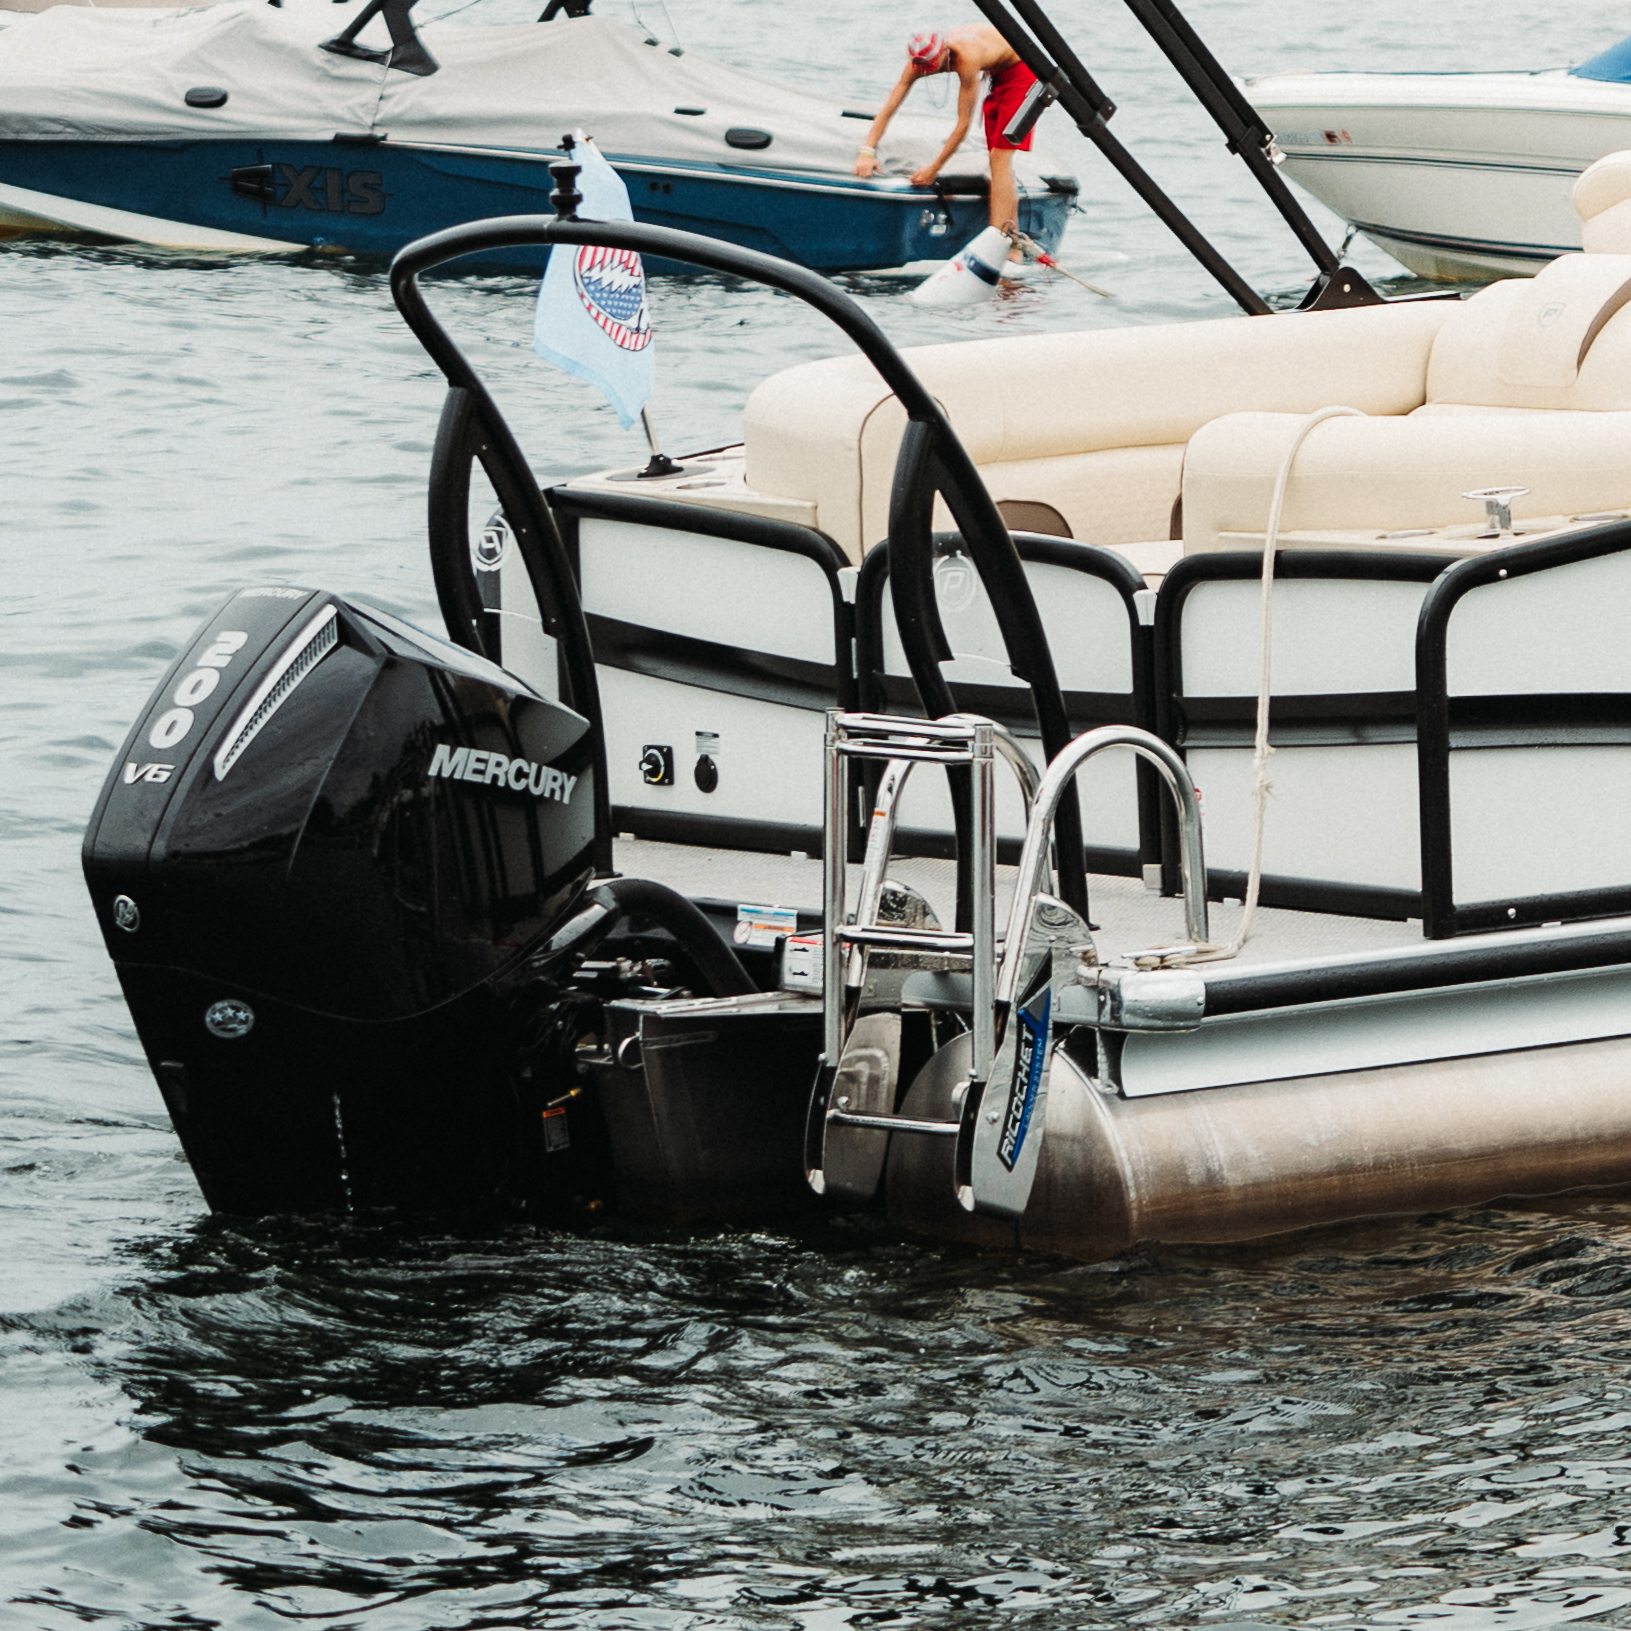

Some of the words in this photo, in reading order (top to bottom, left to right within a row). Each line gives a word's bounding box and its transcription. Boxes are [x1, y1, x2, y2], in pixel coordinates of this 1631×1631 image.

[231, 163, 387, 215] AXIS
[149, 630, 249, 749] 200
[123, 762, 176, 784] V6
[428, 743, 577, 805] MERCURY
[1001, 1023, 1034, 1166] RICOCHET
